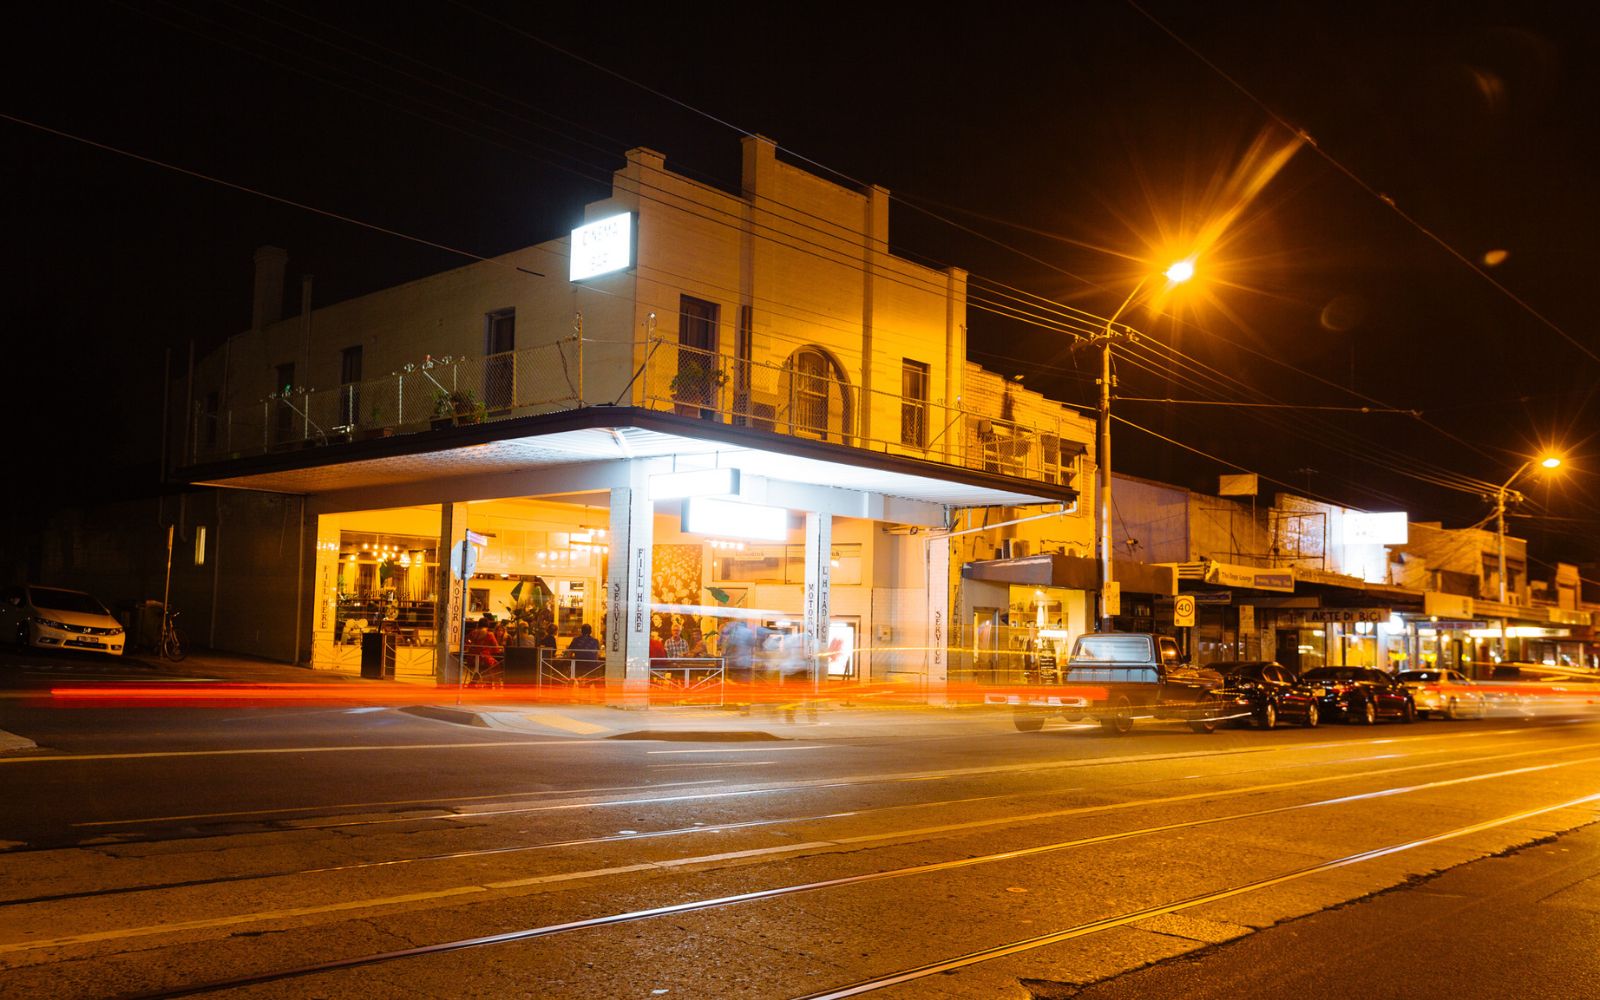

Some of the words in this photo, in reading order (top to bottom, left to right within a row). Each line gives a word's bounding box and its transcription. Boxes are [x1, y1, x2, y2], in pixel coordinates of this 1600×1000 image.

[636, 549, 645, 588] FILL
[320, 600, 328, 629] HERE
[612, 584, 620, 652] SERVICE
[635, 593, 644, 632] HERE
[1178, 603, 1191, 613] 40
[1312, 611, 1340, 621] ARTE
[1344, 611, 1353, 621] DI
